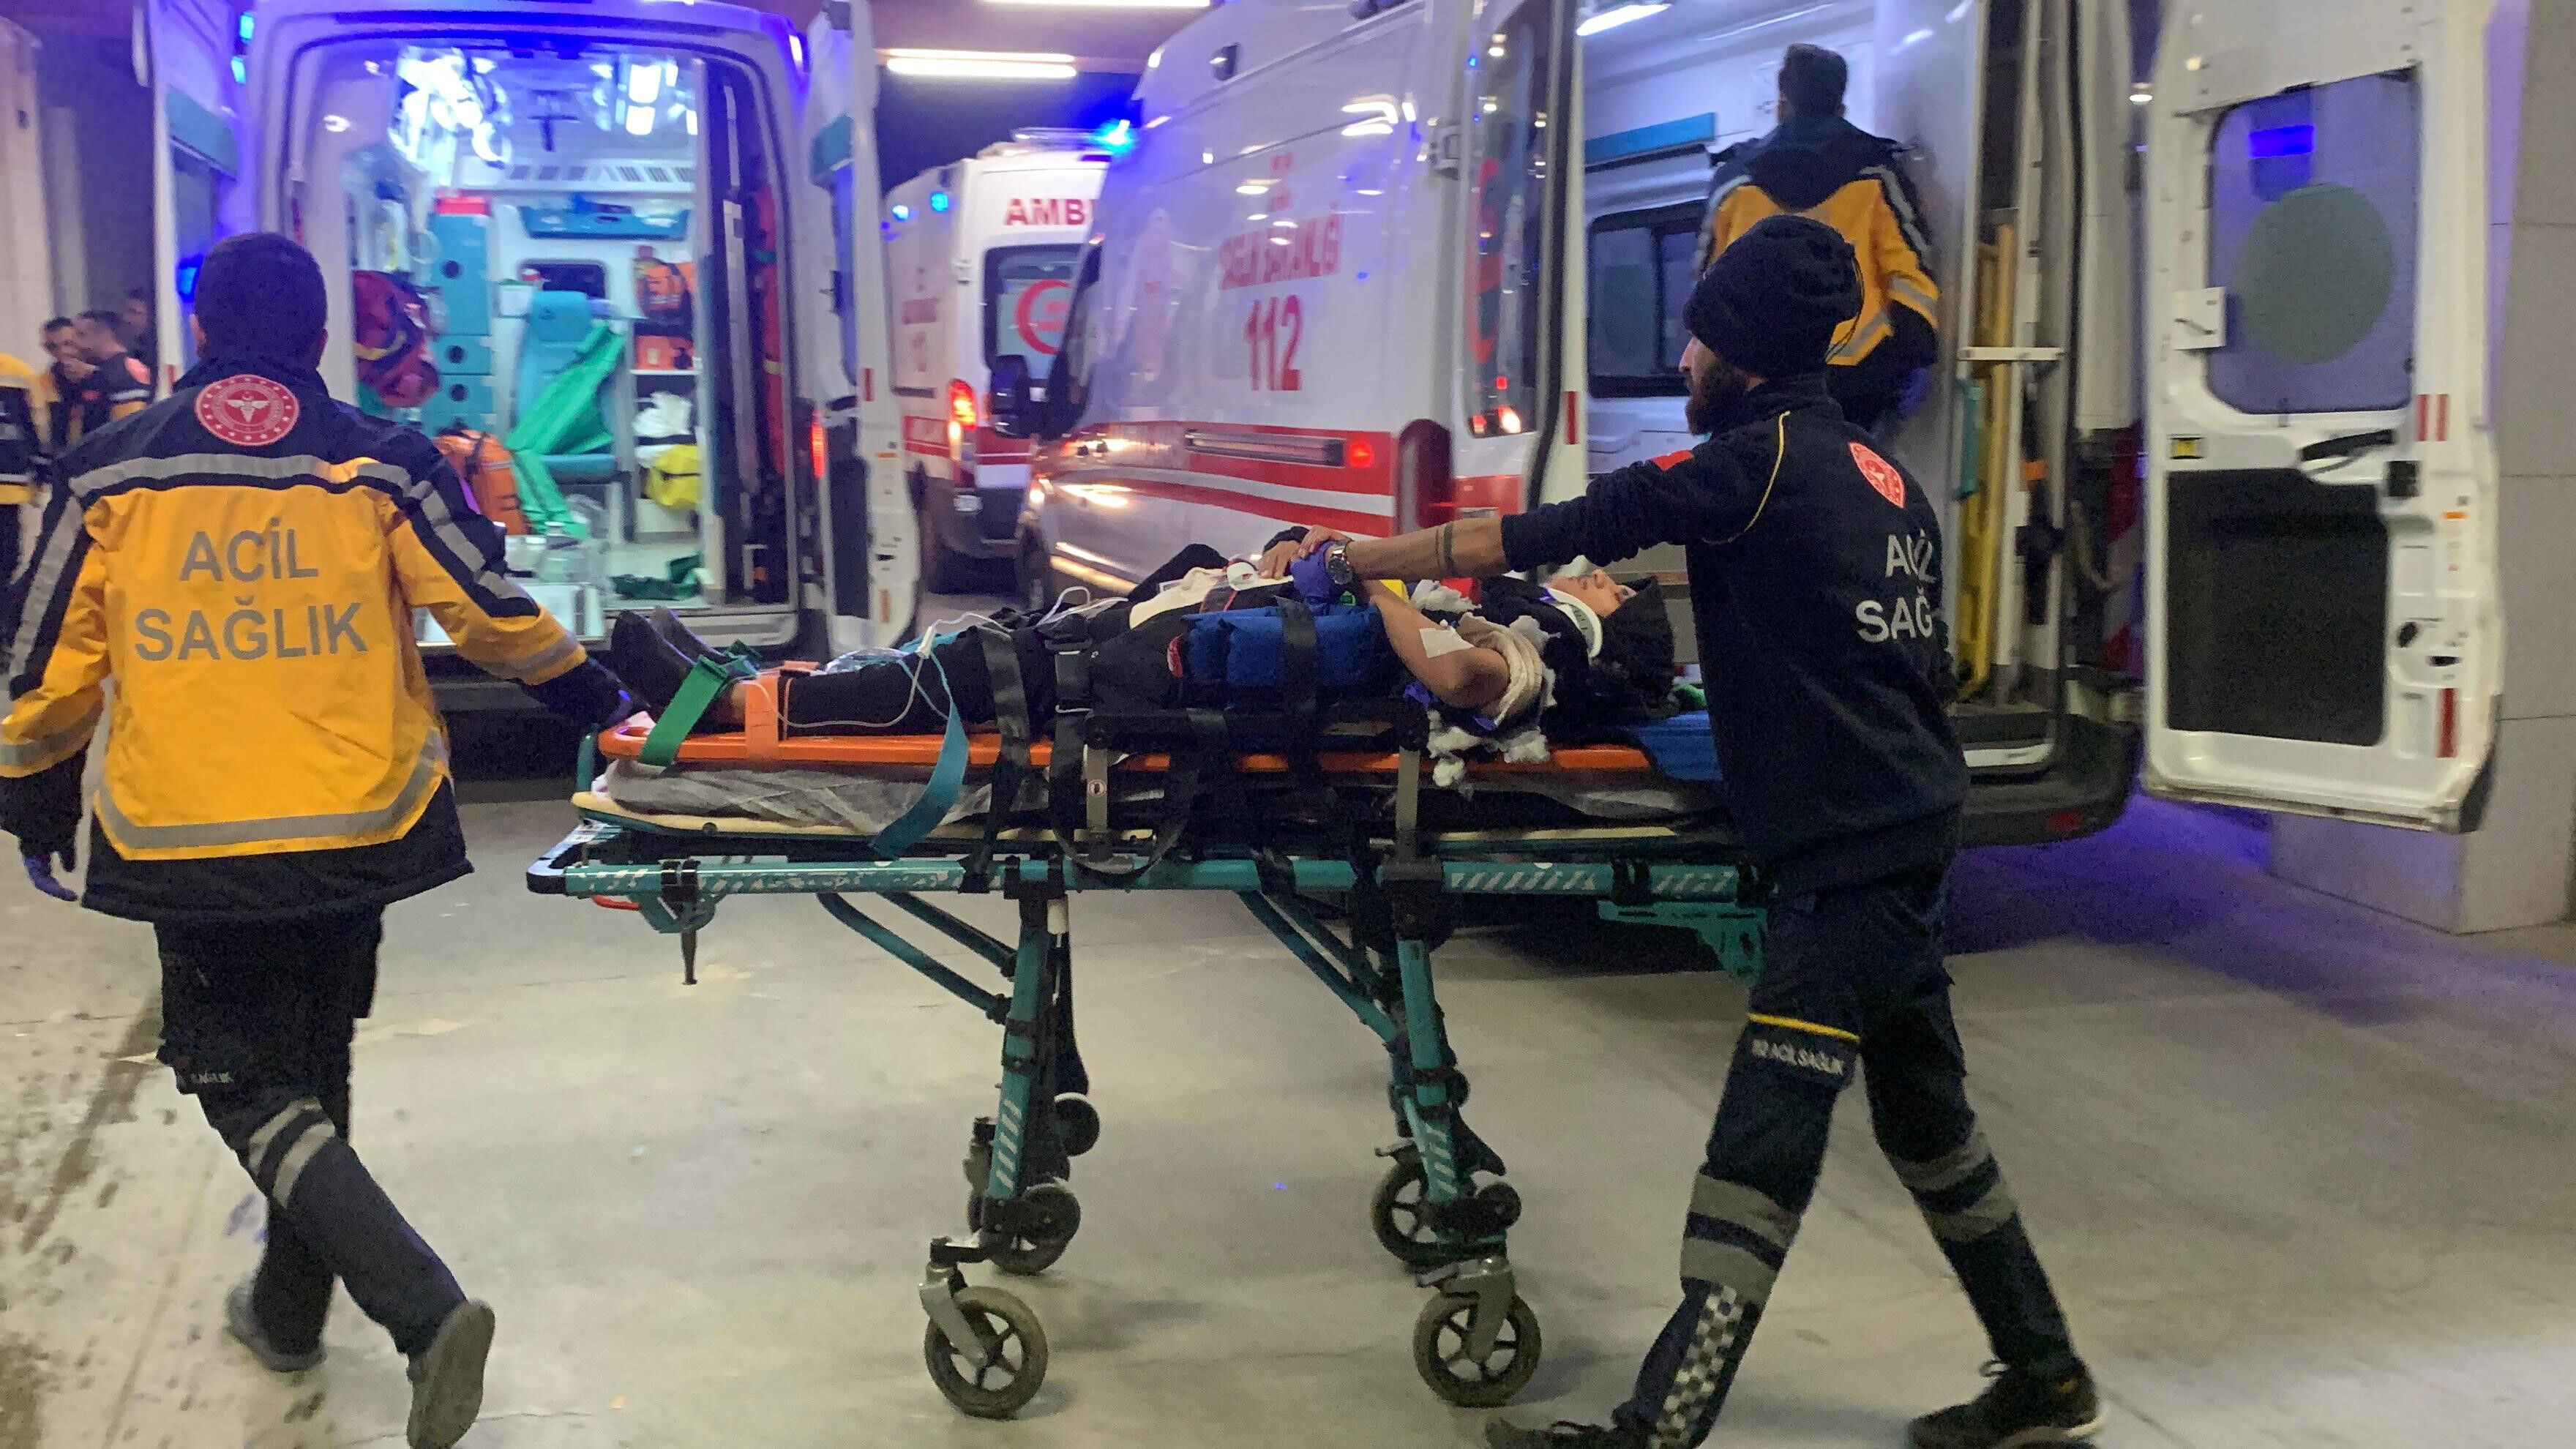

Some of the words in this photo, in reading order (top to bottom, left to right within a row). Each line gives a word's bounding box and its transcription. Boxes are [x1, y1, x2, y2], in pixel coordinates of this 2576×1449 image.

[1005, 198, 1091, 225] AMB
[1245, 294, 1303, 391] 112
[179, 516, 319, 582] ACİL
[135, 595, 369, 661] SAĞLIK
